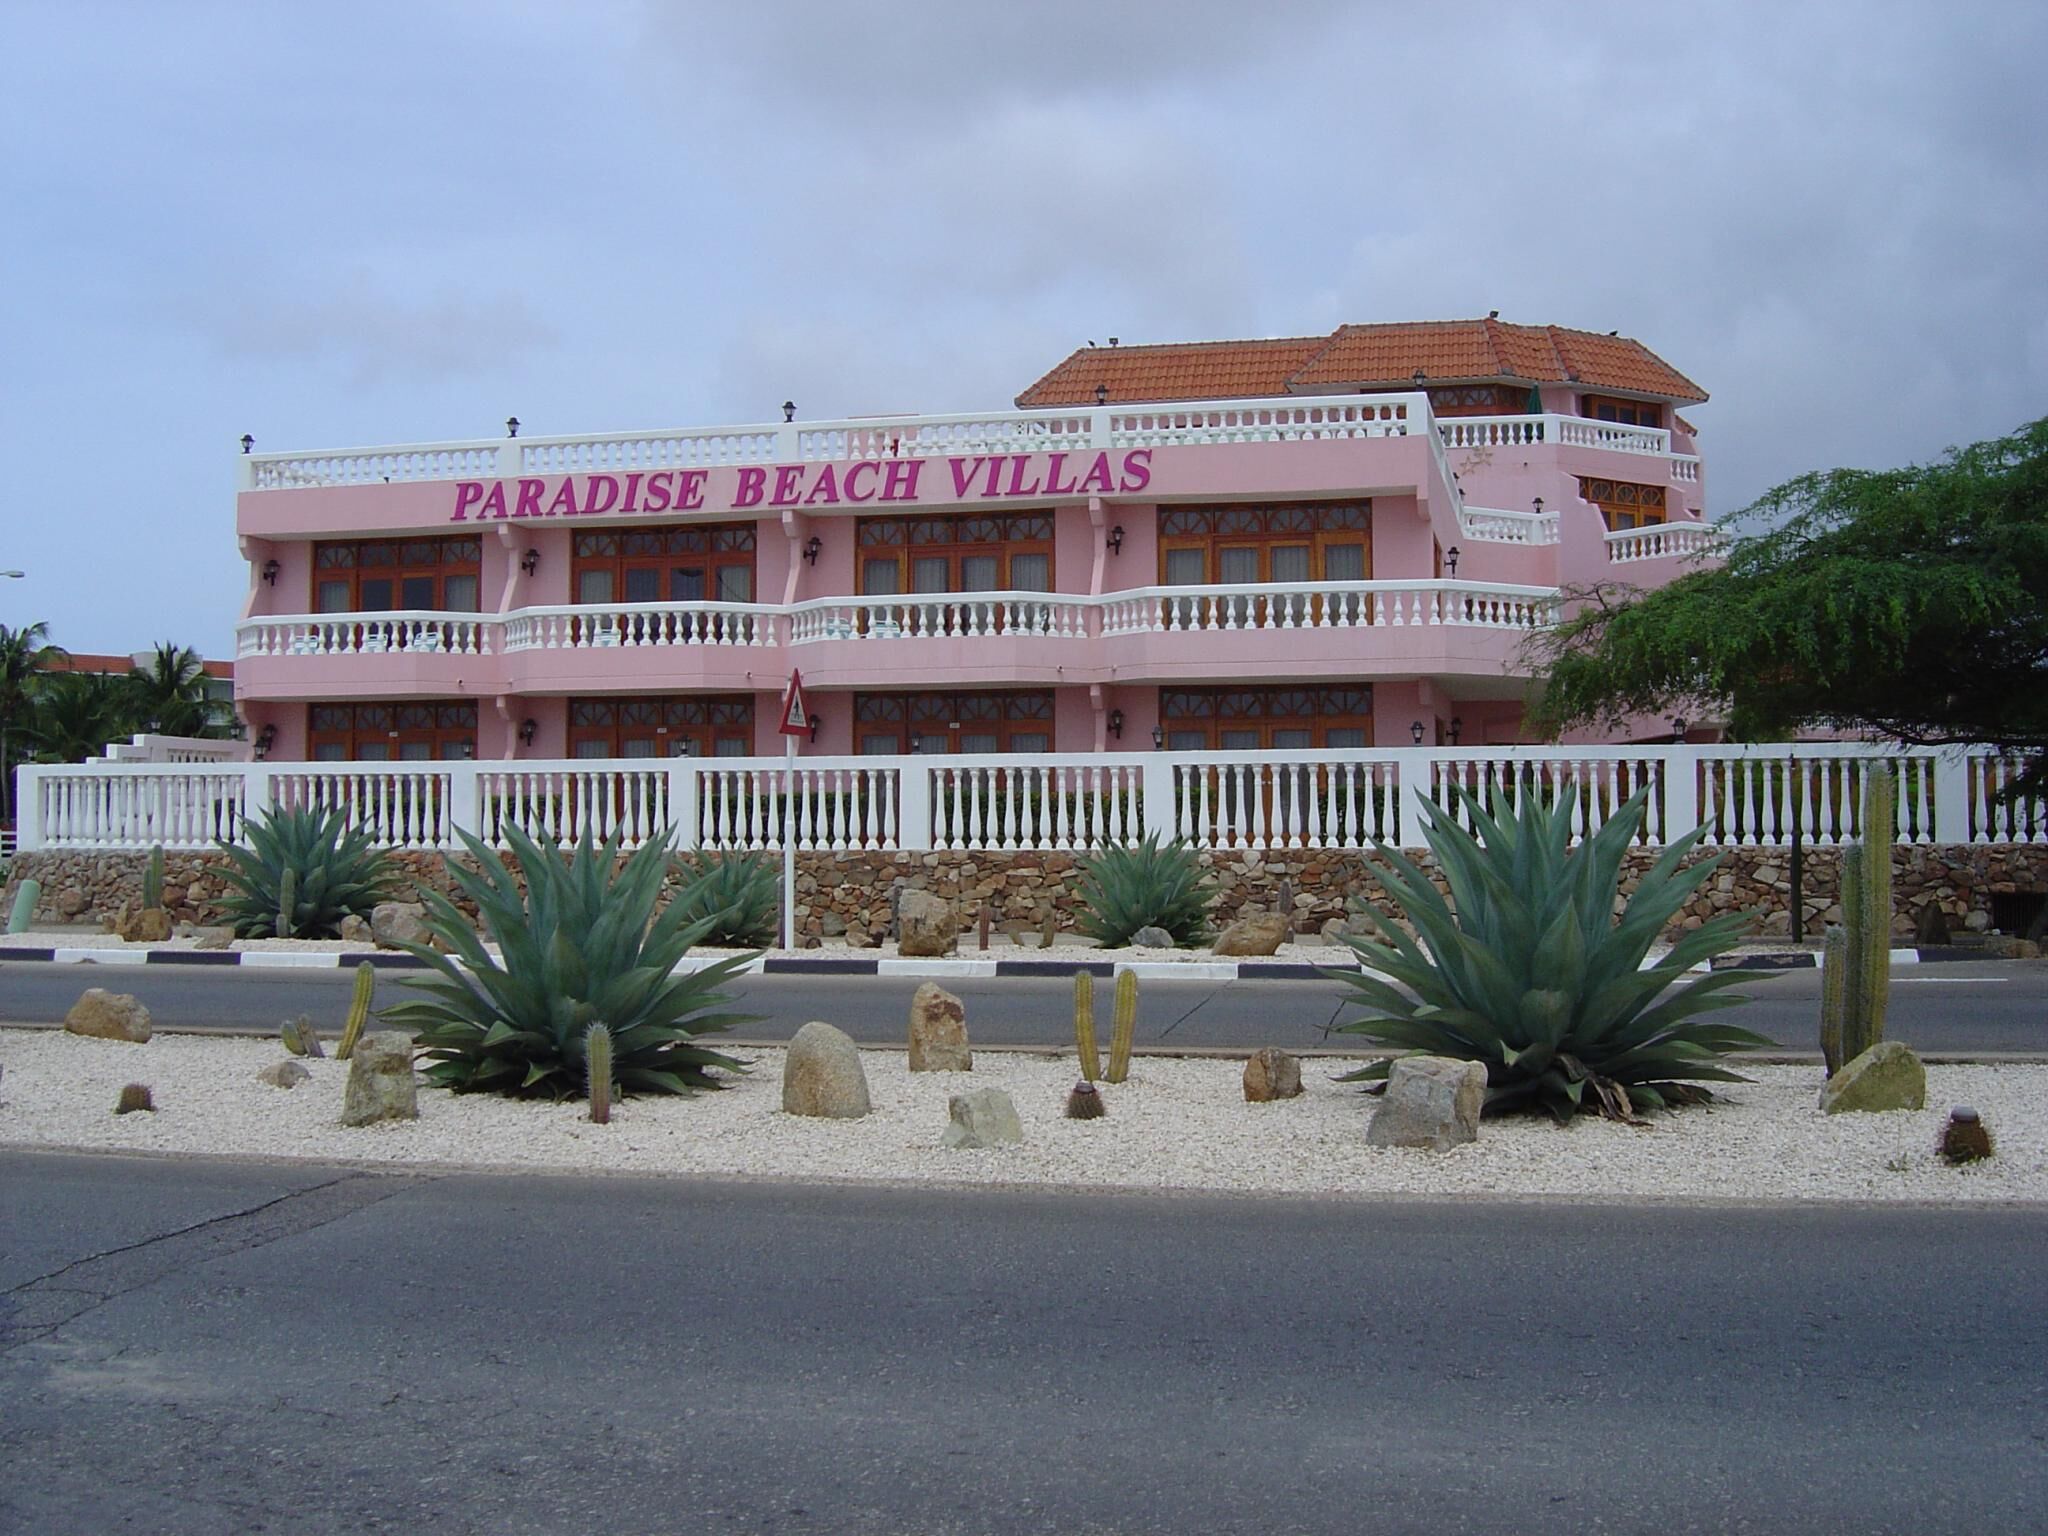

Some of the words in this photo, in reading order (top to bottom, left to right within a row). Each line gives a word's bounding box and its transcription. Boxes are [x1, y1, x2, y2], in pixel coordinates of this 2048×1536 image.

[450, 470, 708, 520] PARADISE
[731, 459, 925, 507] BEACH
[948, 449, 1153, 498] VILLAS
